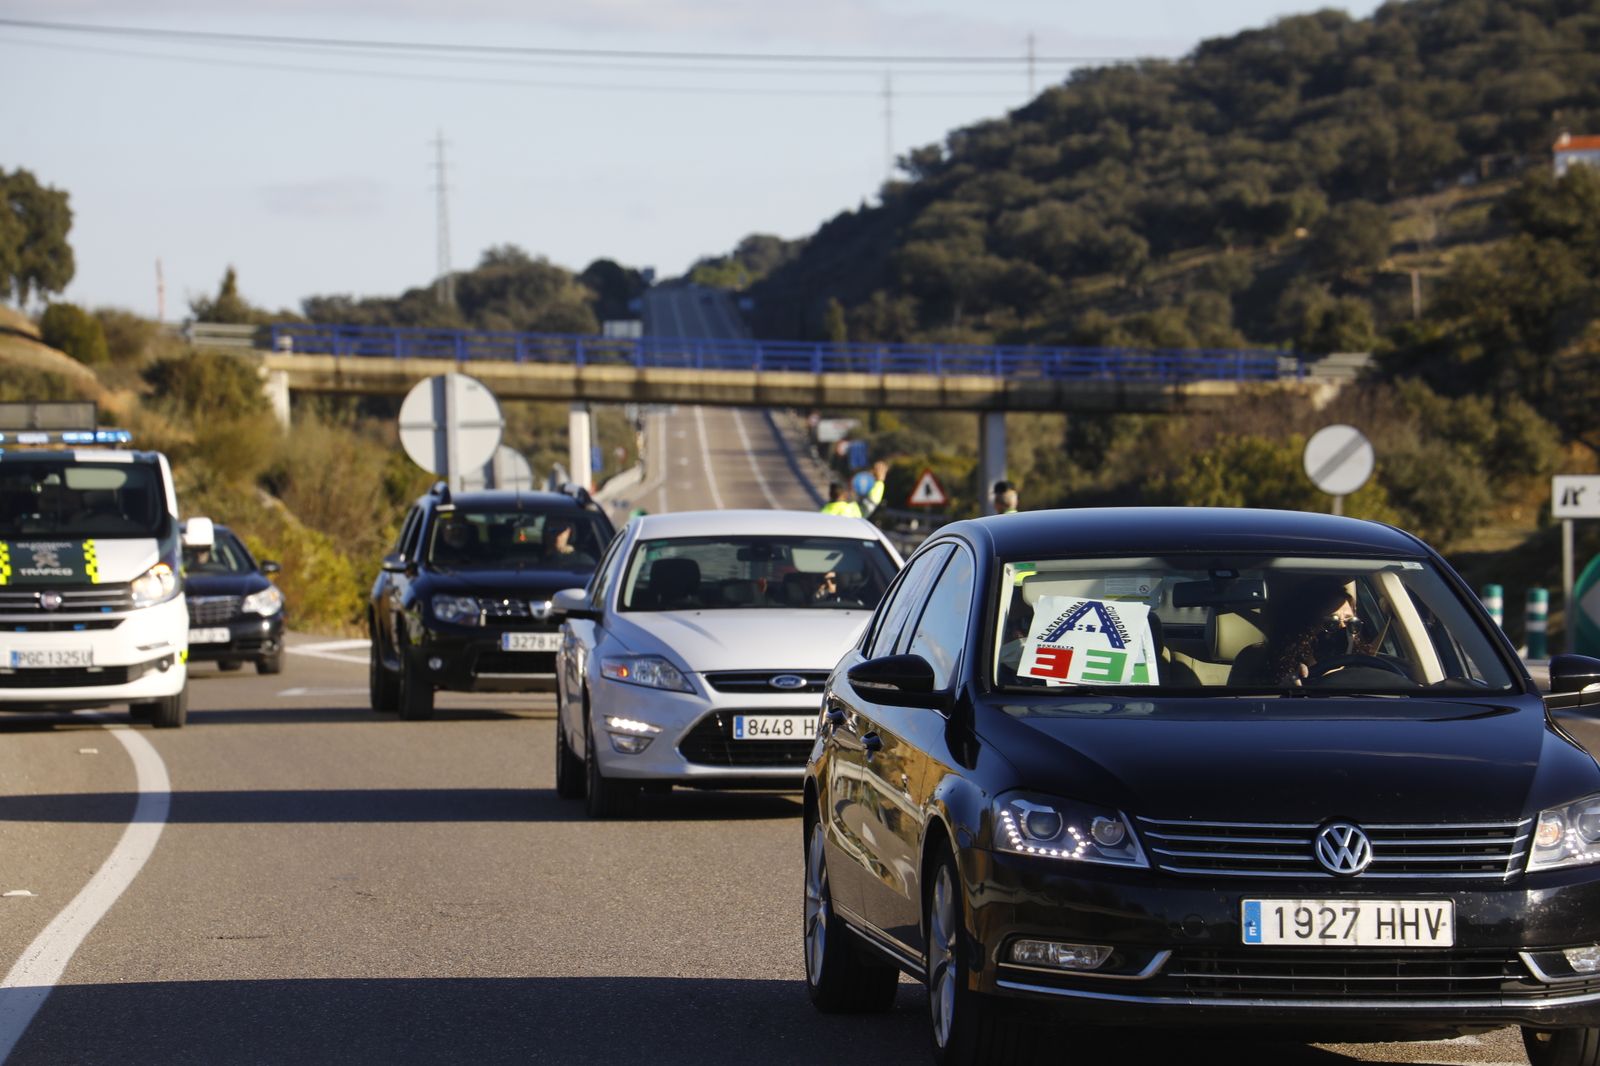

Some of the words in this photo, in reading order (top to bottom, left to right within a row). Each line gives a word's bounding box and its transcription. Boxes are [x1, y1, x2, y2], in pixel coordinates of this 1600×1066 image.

[1036, 600, 1086, 641] PLATAFORMA
[1105, 605, 1132, 645] CIUDADANA
[512, 636, 546, 648] 3278
[748, 719, 794, 736] 8448
[804, 719, 817, 736] H
[1249, 927, 1257, 937] E
[1275, 906, 1361, 940] 1927
[1376, 907, 1443, 941] HHV
